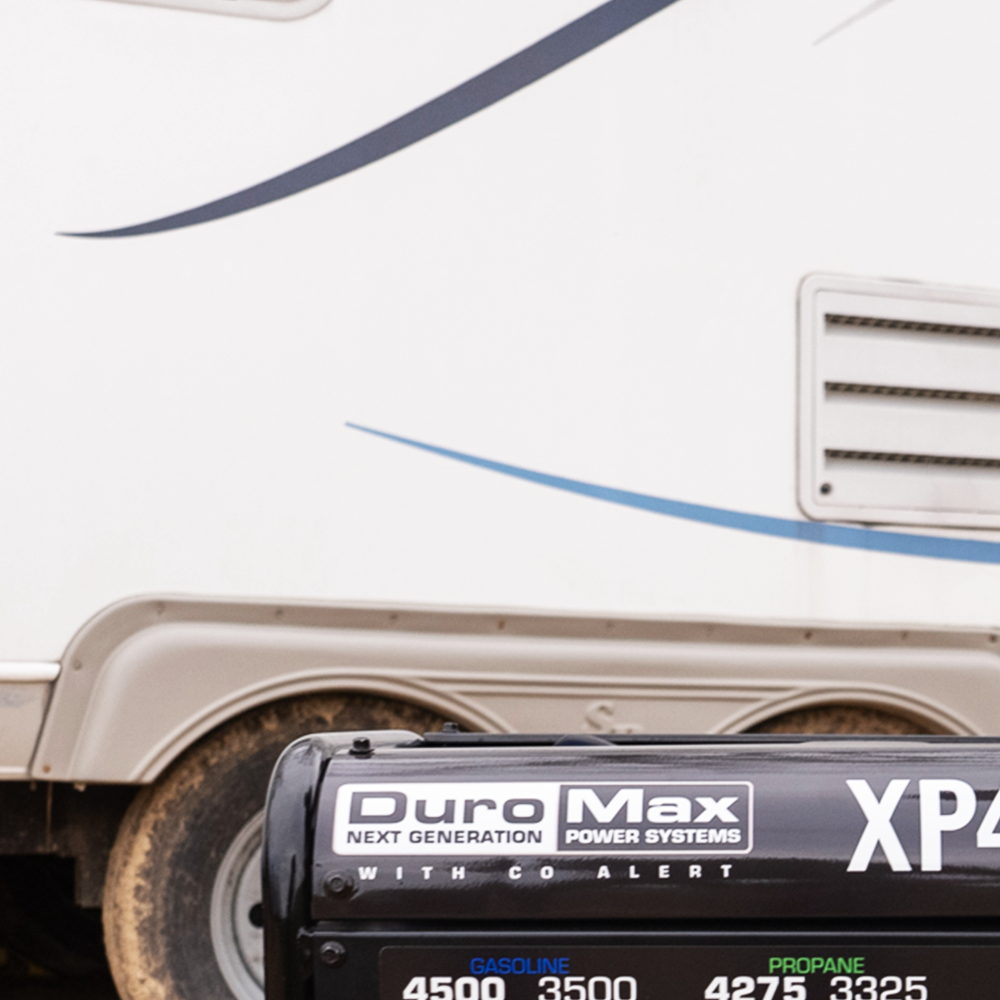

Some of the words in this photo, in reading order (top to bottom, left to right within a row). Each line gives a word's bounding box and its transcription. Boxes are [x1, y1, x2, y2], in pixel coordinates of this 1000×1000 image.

[348, 791, 545, 825] Duro
[566, 788, 739, 824] Max
[347, 830, 402, 844] NEXT
[408, 830, 543, 845] GENERATION
[565, 829, 640, 845] POWER
[645, 828, 742, 844] SYSTEMS
[358, 865, 466, 881] WITH
[508, 864, 555, 880] CO
[597, 863, 733, 880] ALERT
[469, 957, 571, 975] GASOLINE
[768, 956, 866, 974] PROPANE
